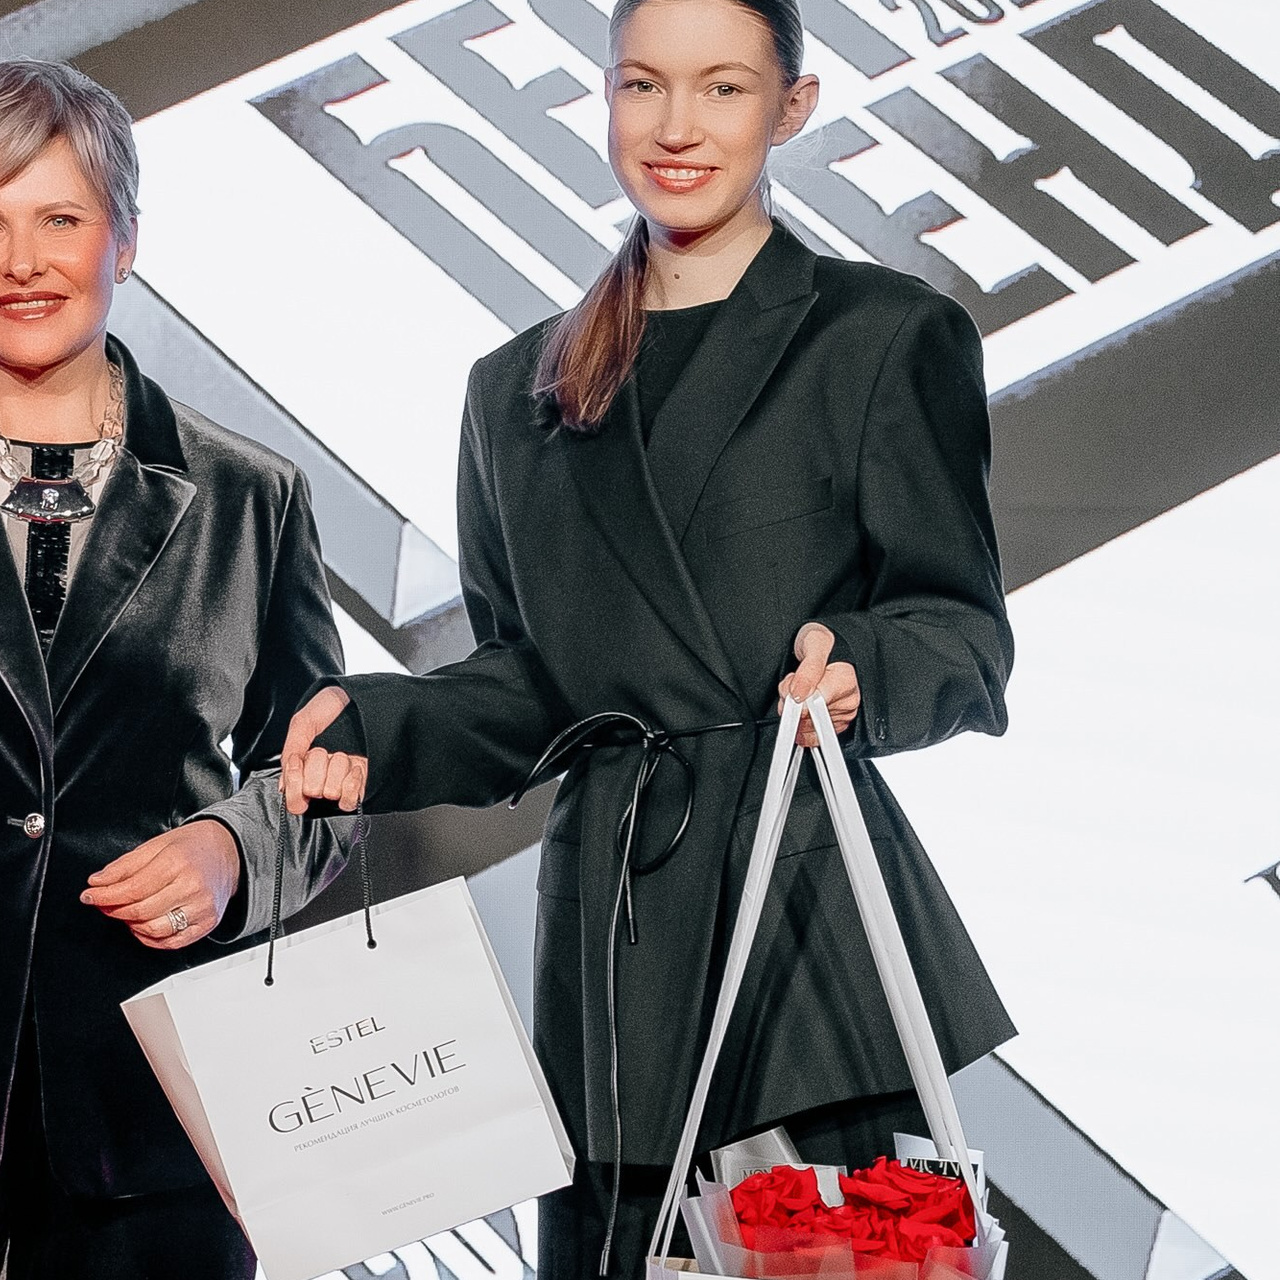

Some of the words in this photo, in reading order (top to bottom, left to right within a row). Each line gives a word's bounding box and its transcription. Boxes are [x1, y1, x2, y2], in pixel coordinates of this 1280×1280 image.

[309, 1016, 386, 1055] ESTEL
[268, 1039, 467, 1134] GÈNEVIE
[293, 1124, 359, 1153] РЕКОМЕНДАЦИЯ
[359, 1109, 395, 1128] ЛУЧШИХ
[395, 1085, 461, 1116] КОСМЕТОЛОГОВ
